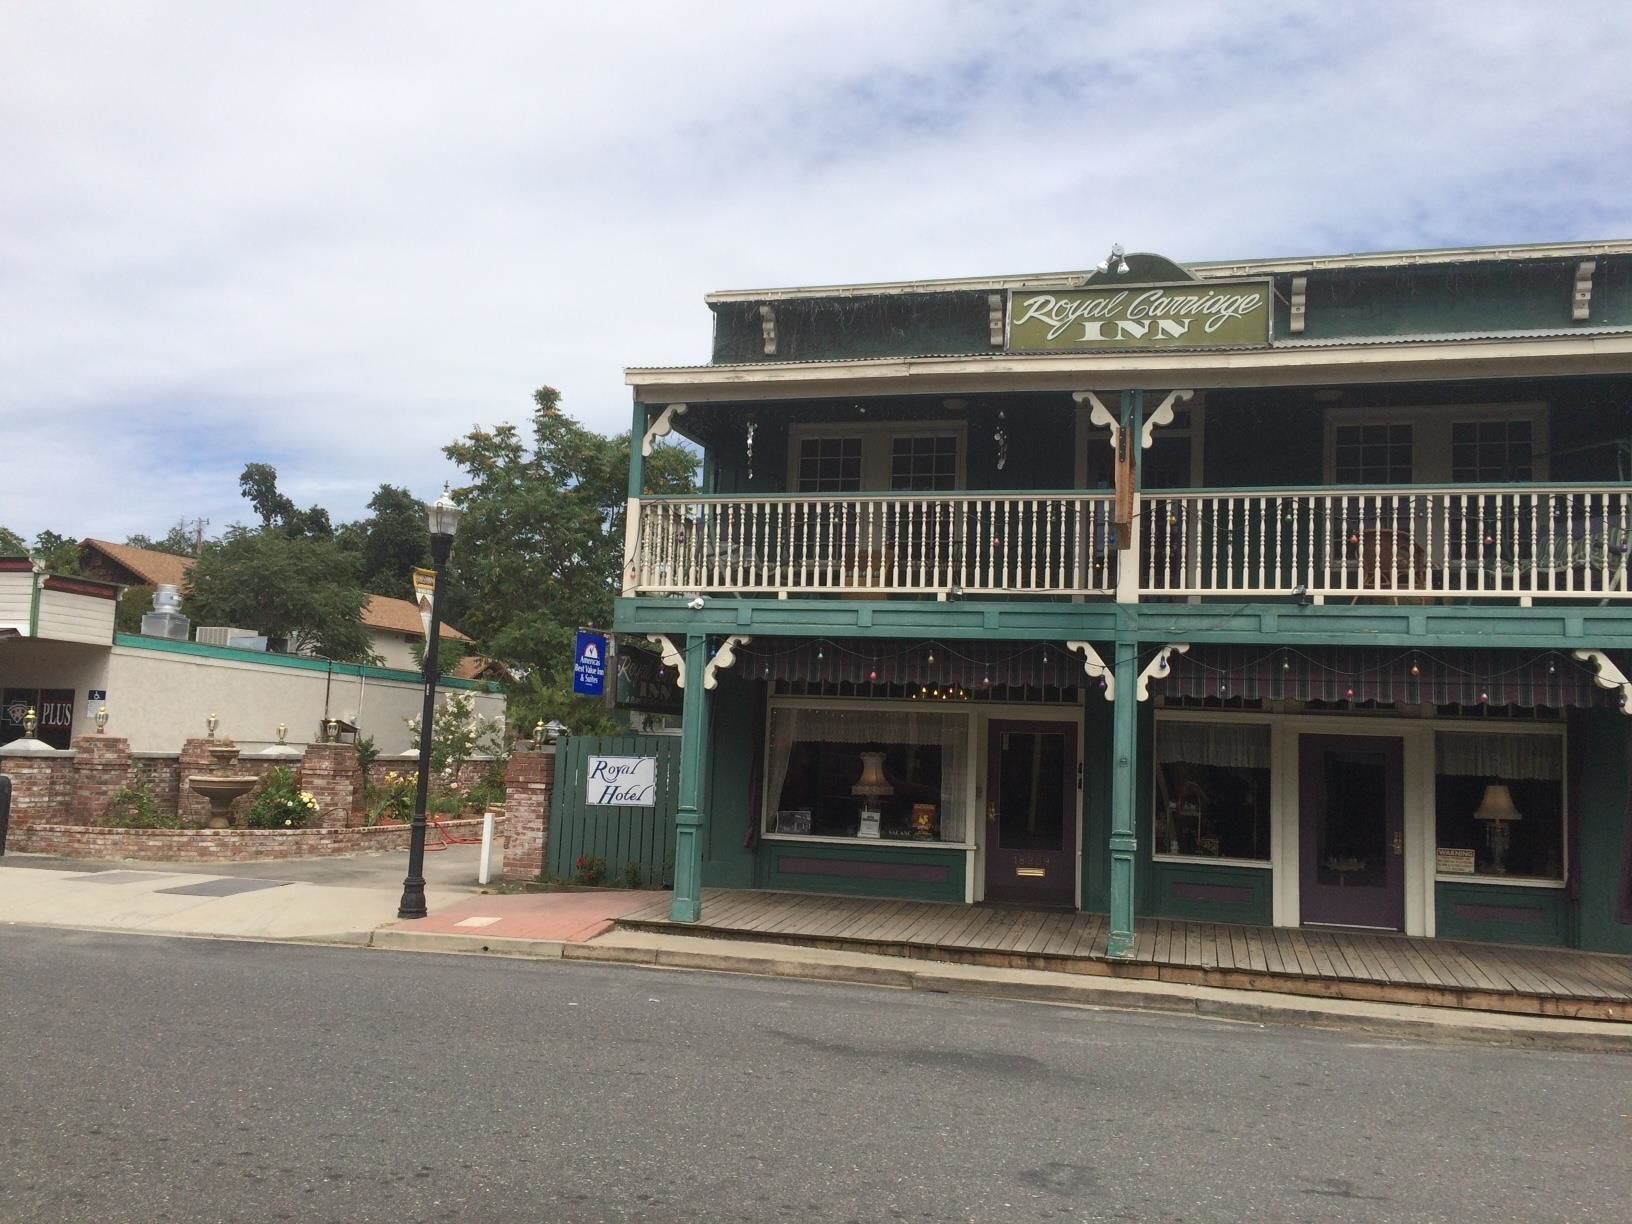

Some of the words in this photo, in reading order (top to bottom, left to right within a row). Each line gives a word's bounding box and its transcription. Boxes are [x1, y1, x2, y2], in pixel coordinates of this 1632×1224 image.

[1014, 291, 1128, 340] Royal
[1126, 289, 1263, 333] Carriage
[1075, 319, 1195, 341] INN
[575, 663, 585, 673] Best
[585, 664, 597, 675] Value
[597, 667, 605, 676] Inn
[580, 673, 585, 681] &
[585, 673, 599, 684] Suites
[41, 703, 73, 726] PLUS
[588, 758, 647, 783] Royal
[596, 785, 654, 804] Hotel
[1437, 849, 1474, 857] WARNING
